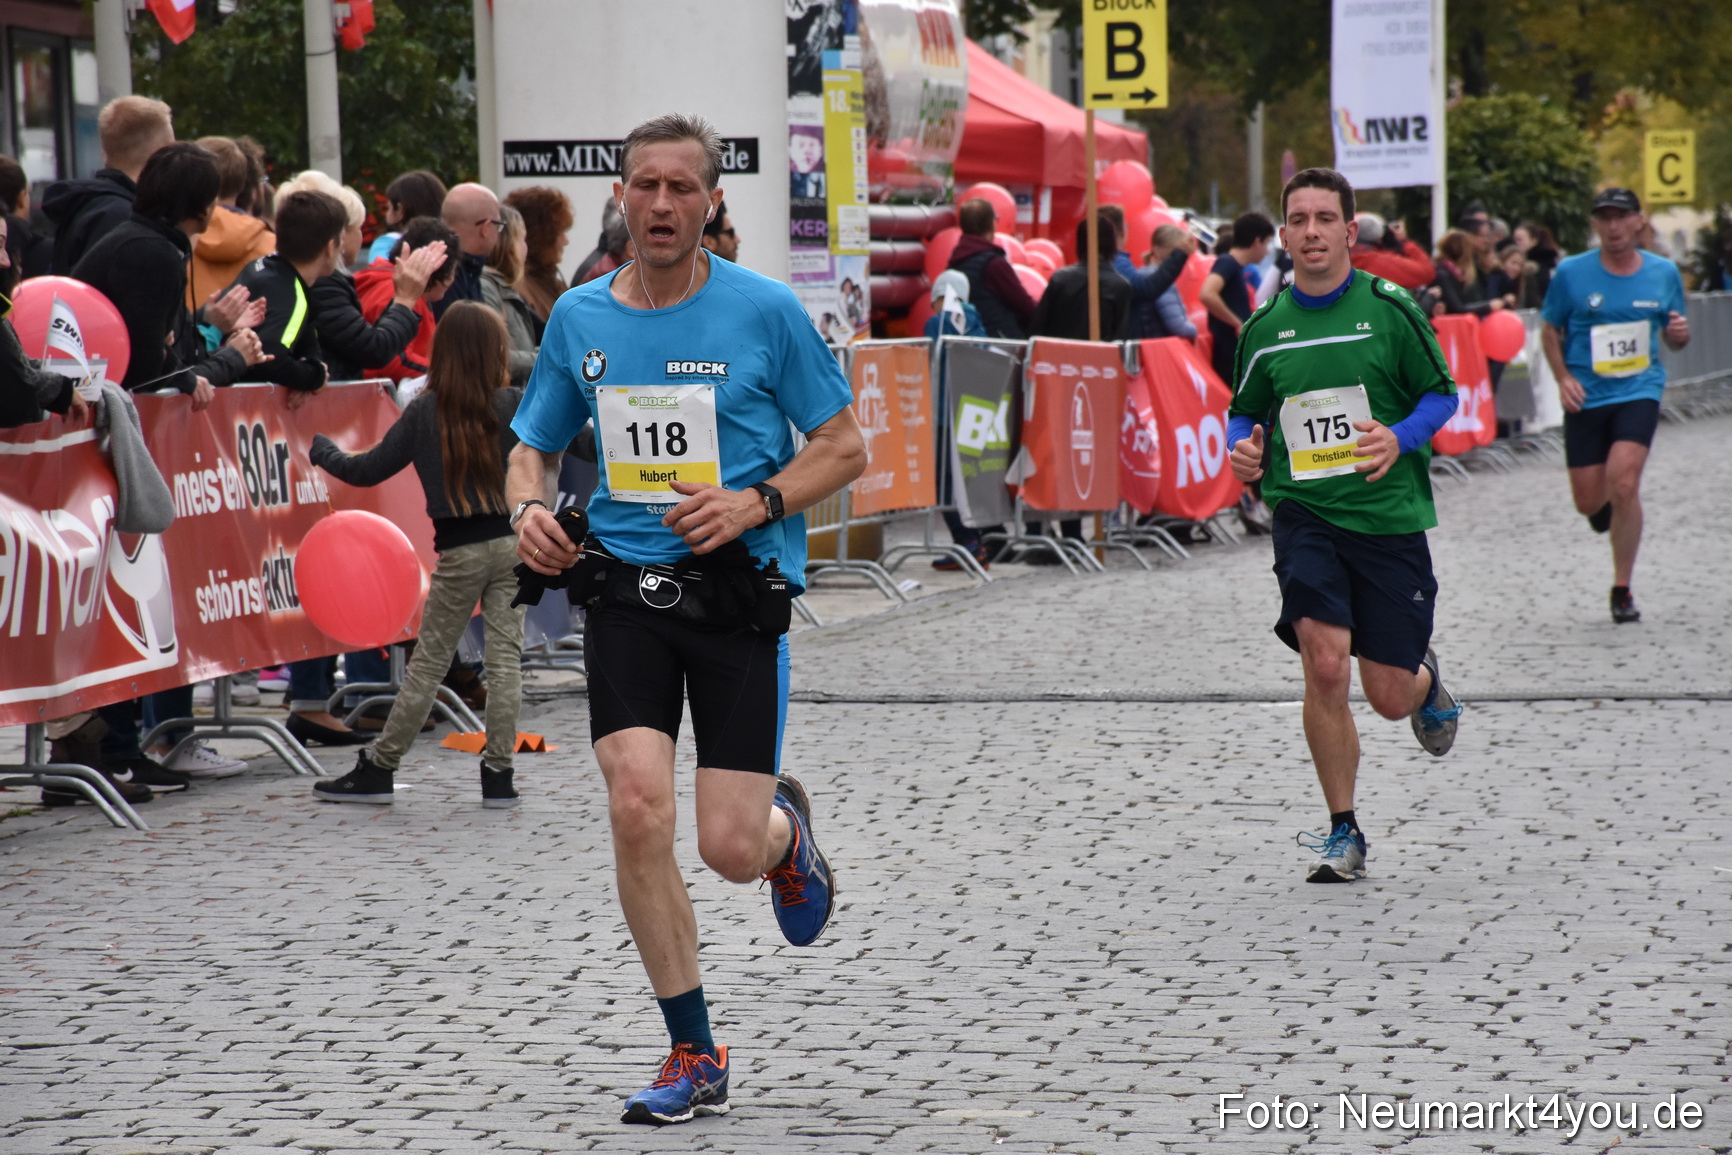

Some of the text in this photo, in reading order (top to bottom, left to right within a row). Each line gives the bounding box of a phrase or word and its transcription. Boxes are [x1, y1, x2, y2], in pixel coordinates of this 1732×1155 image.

[1106, 22, 1146, 80] B
[1657, 153, 1681, 185] C
[791, 219, 829, 238] KER
[1278, 329, 1296, 339] JAKO
[1356, 322, 1371, 330] C.R.
[1607, 339, 1637, 357] 134
[666, 361, 728, 375] BOCK
[640, 396, 679, 406] BOCK
[1309, 396, 1340, 408] BOCK
[1303, 413, 1351, 444] 175
[626, 422, 688, 457] 118
[608, 450, 615, 458] C
[1175, 409, 1231, 488] RO
[1312, 449, 1352, 463] Christian
[640, 470, 678, 482] Hubert
[173, 452, 247, 518] meisten
[646, 504, 677, 515] Stad
[196, 570, 263, 624] schöns
